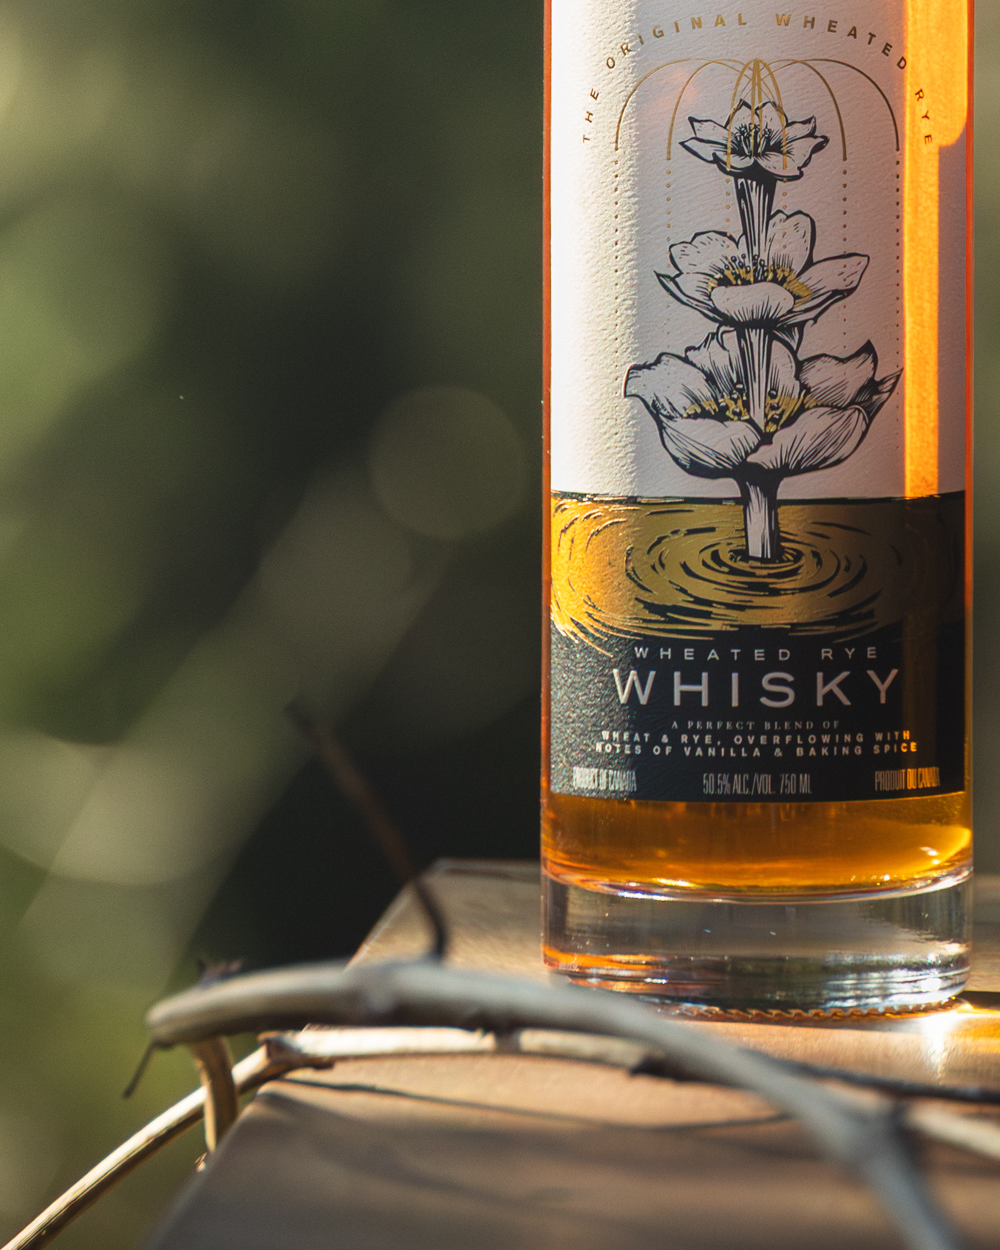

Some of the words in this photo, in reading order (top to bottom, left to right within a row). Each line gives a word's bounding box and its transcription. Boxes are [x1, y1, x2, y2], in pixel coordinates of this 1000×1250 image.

[582, 88, 600, 143] THE
[605, 12, 747, 70] ORIGINAL
[775, 13, 908, 70] WHEATED
[915, 88, 933, 145] RYE
[634, 647, 791, 661] WHEATED
[821, 646, 878, 660] RYE
[612, 668, 899, 708] WHISKY
[671, 720, 678, 730] A
[687, 720, 755, 730] PERFECT
[764, 720, 814, 730] BLEND
[822, 720, 840, 730] OF
[601, 730, 651, 743] WHEAT
[661, 734, 669, 743] &
[680, 733, 721, 746] RYE,
[733, 732, 864, 745] OVERFLOWING
[874, 730, 911, 742] WITH
[595, 741, 642, 755] NOTES
[652, 745, 672, 756] OF
[683, 745, 761, 757] VANILLA
[796, 745, 862, 757] BAKING
[873, 741, 918, 755] SPICE
[779, 772, 797, 795] 750
